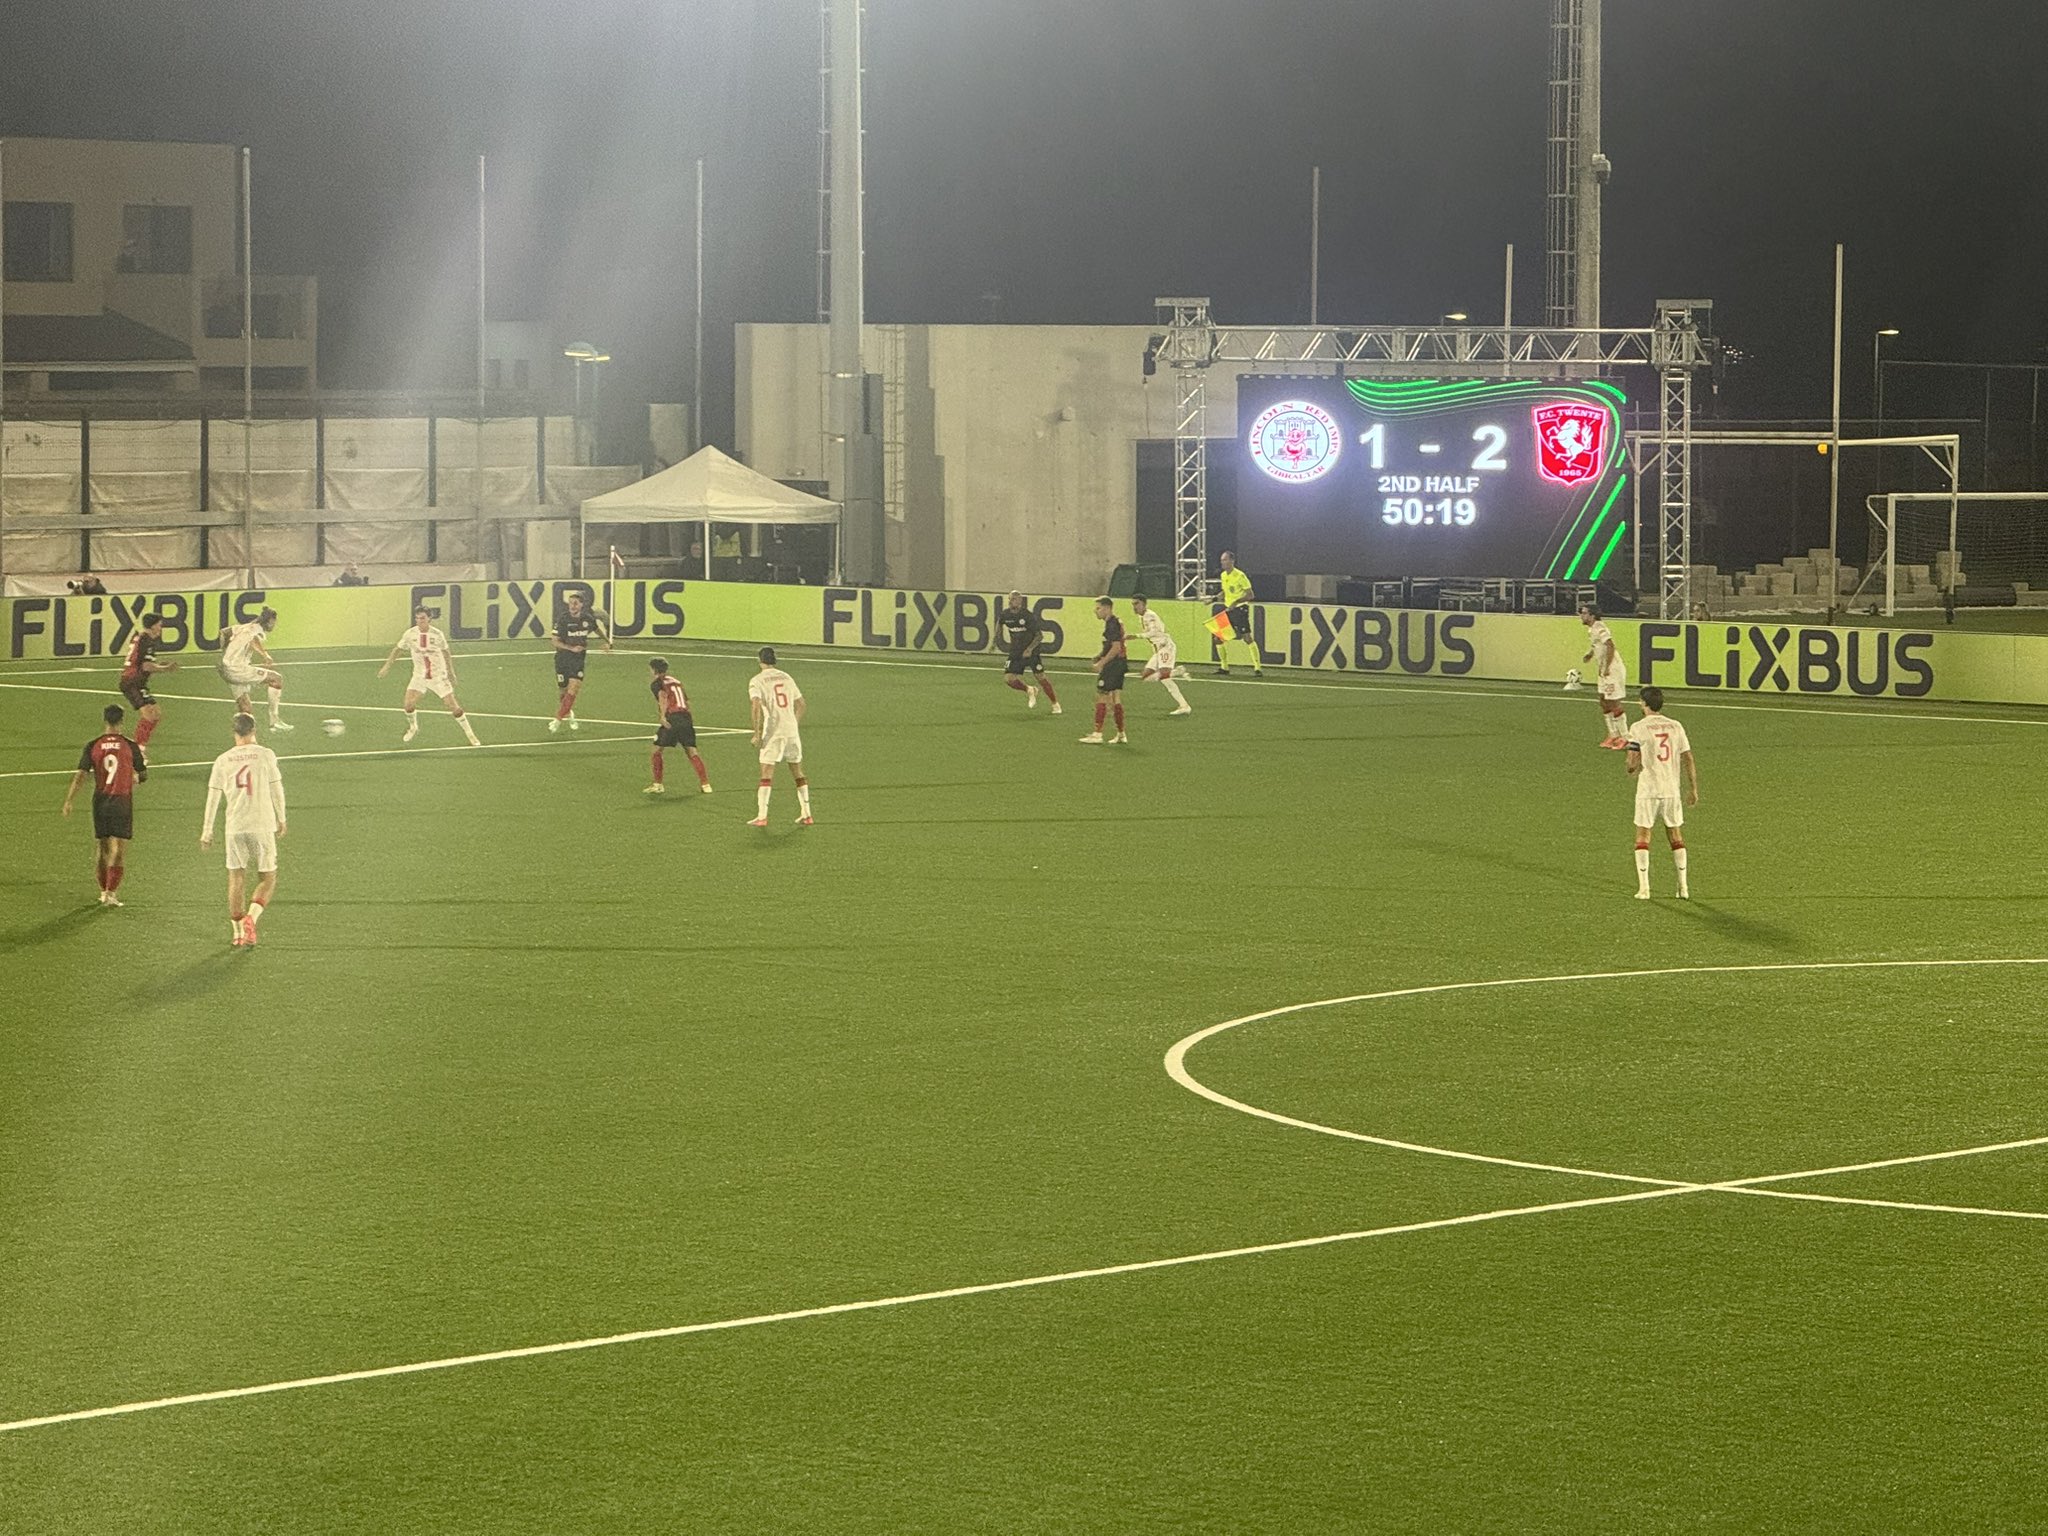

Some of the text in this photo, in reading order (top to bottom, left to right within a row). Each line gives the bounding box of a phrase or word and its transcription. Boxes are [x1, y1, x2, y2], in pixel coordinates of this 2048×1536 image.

[1539, 408, 1602, 420] F.C. TWENTE
[1252, 403, 1339, 455] LINCOLN RED IMPS
[1360, 423, 1386, 469] 1
[1472, 425, 1507, 470] 2
[1266, 464, 1326, 479] GIBRALTAR
[1378, 475, 1480, 493] 2ND HALF
[1559, 469, 1582, 477] 1965
[1382, 498, 1476, 526] 50:19
[671, 685, 686, 708] 11
[774, 684, 788, 708] 6
[1655, 733, 1669, 761] 3
[103, 754, 118, 784] 9
[235, 765, 253, 796] 4
